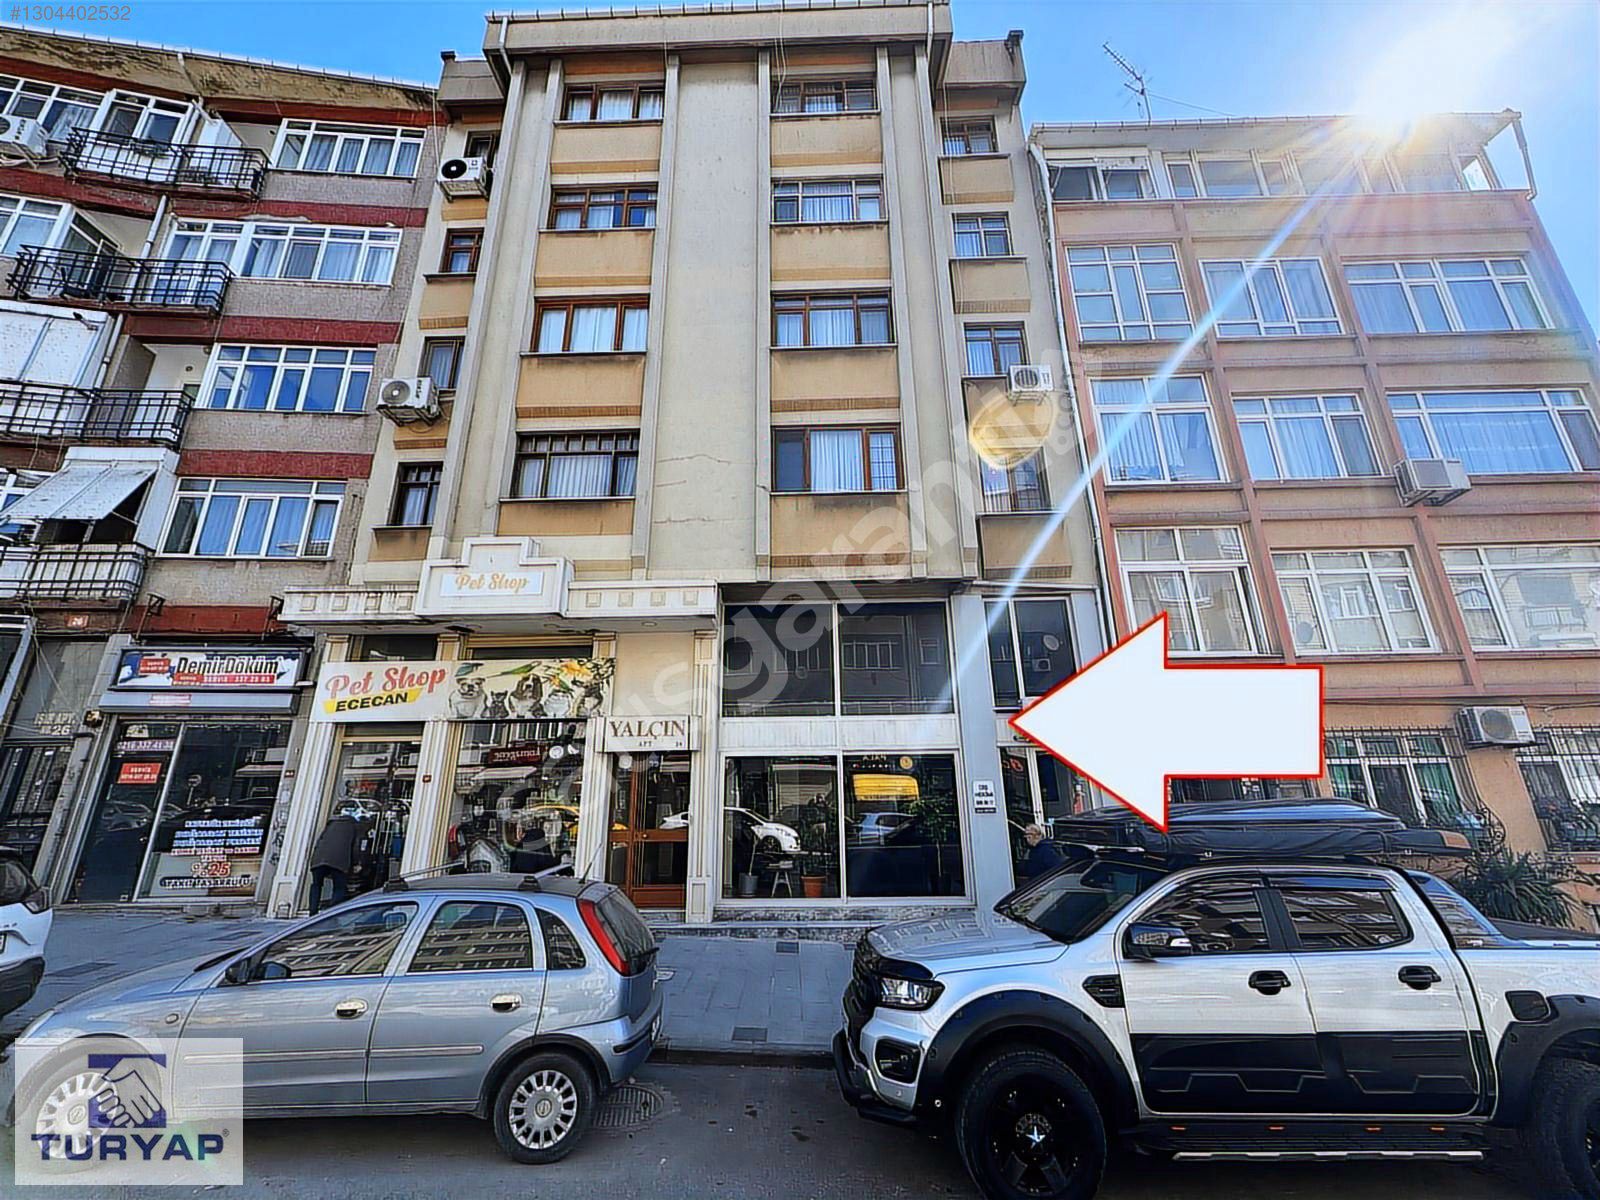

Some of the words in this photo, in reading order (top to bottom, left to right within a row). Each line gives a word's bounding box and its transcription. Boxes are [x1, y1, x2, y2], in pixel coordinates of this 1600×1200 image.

[456, 573, 485, 591] Pet
[488, 572, 531, 594] Shop
[176, 655, 279, 675] DemirDöküm
[325, 671, 374, 699] Pet
[382, 666, 447, 694] Shop
[335, 692, 409, 713] ECECAN
[609, 719, 686, 740] YALÇIN
